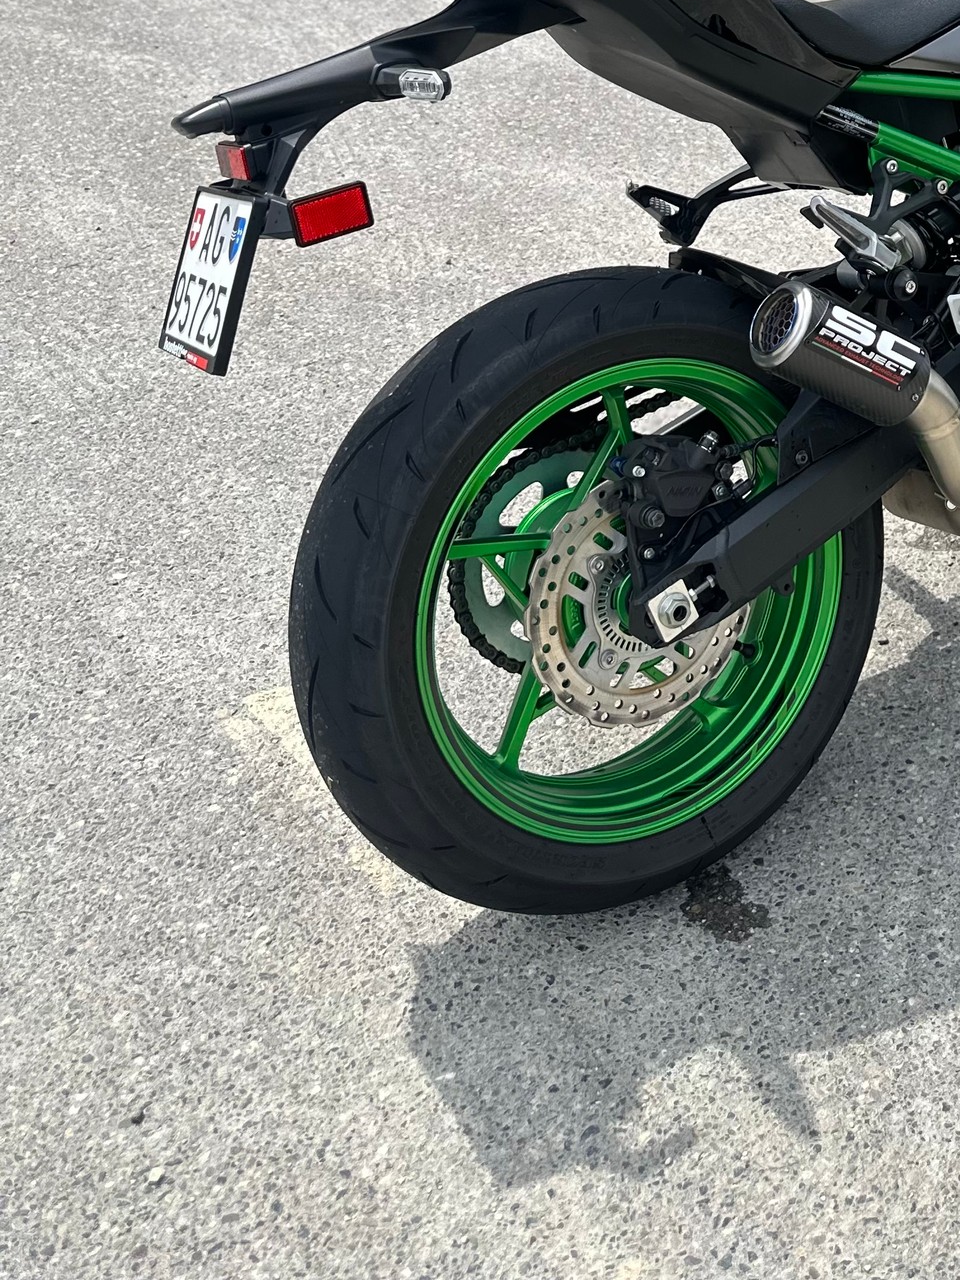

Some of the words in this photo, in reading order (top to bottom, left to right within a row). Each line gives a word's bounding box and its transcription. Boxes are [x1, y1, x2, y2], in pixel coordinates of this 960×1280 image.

[198, 202, 232, 265] AG
[168, 271, 228, 348] 95725
[824, 304, 921, 370] SC
[814, 336, 845, 354] ADVANCED
[843, 350, 871, 368] EXHAUST
[867, 361, 905, 382] TECHNOLOGY
[818, 327, 911, 376] PROJECT
